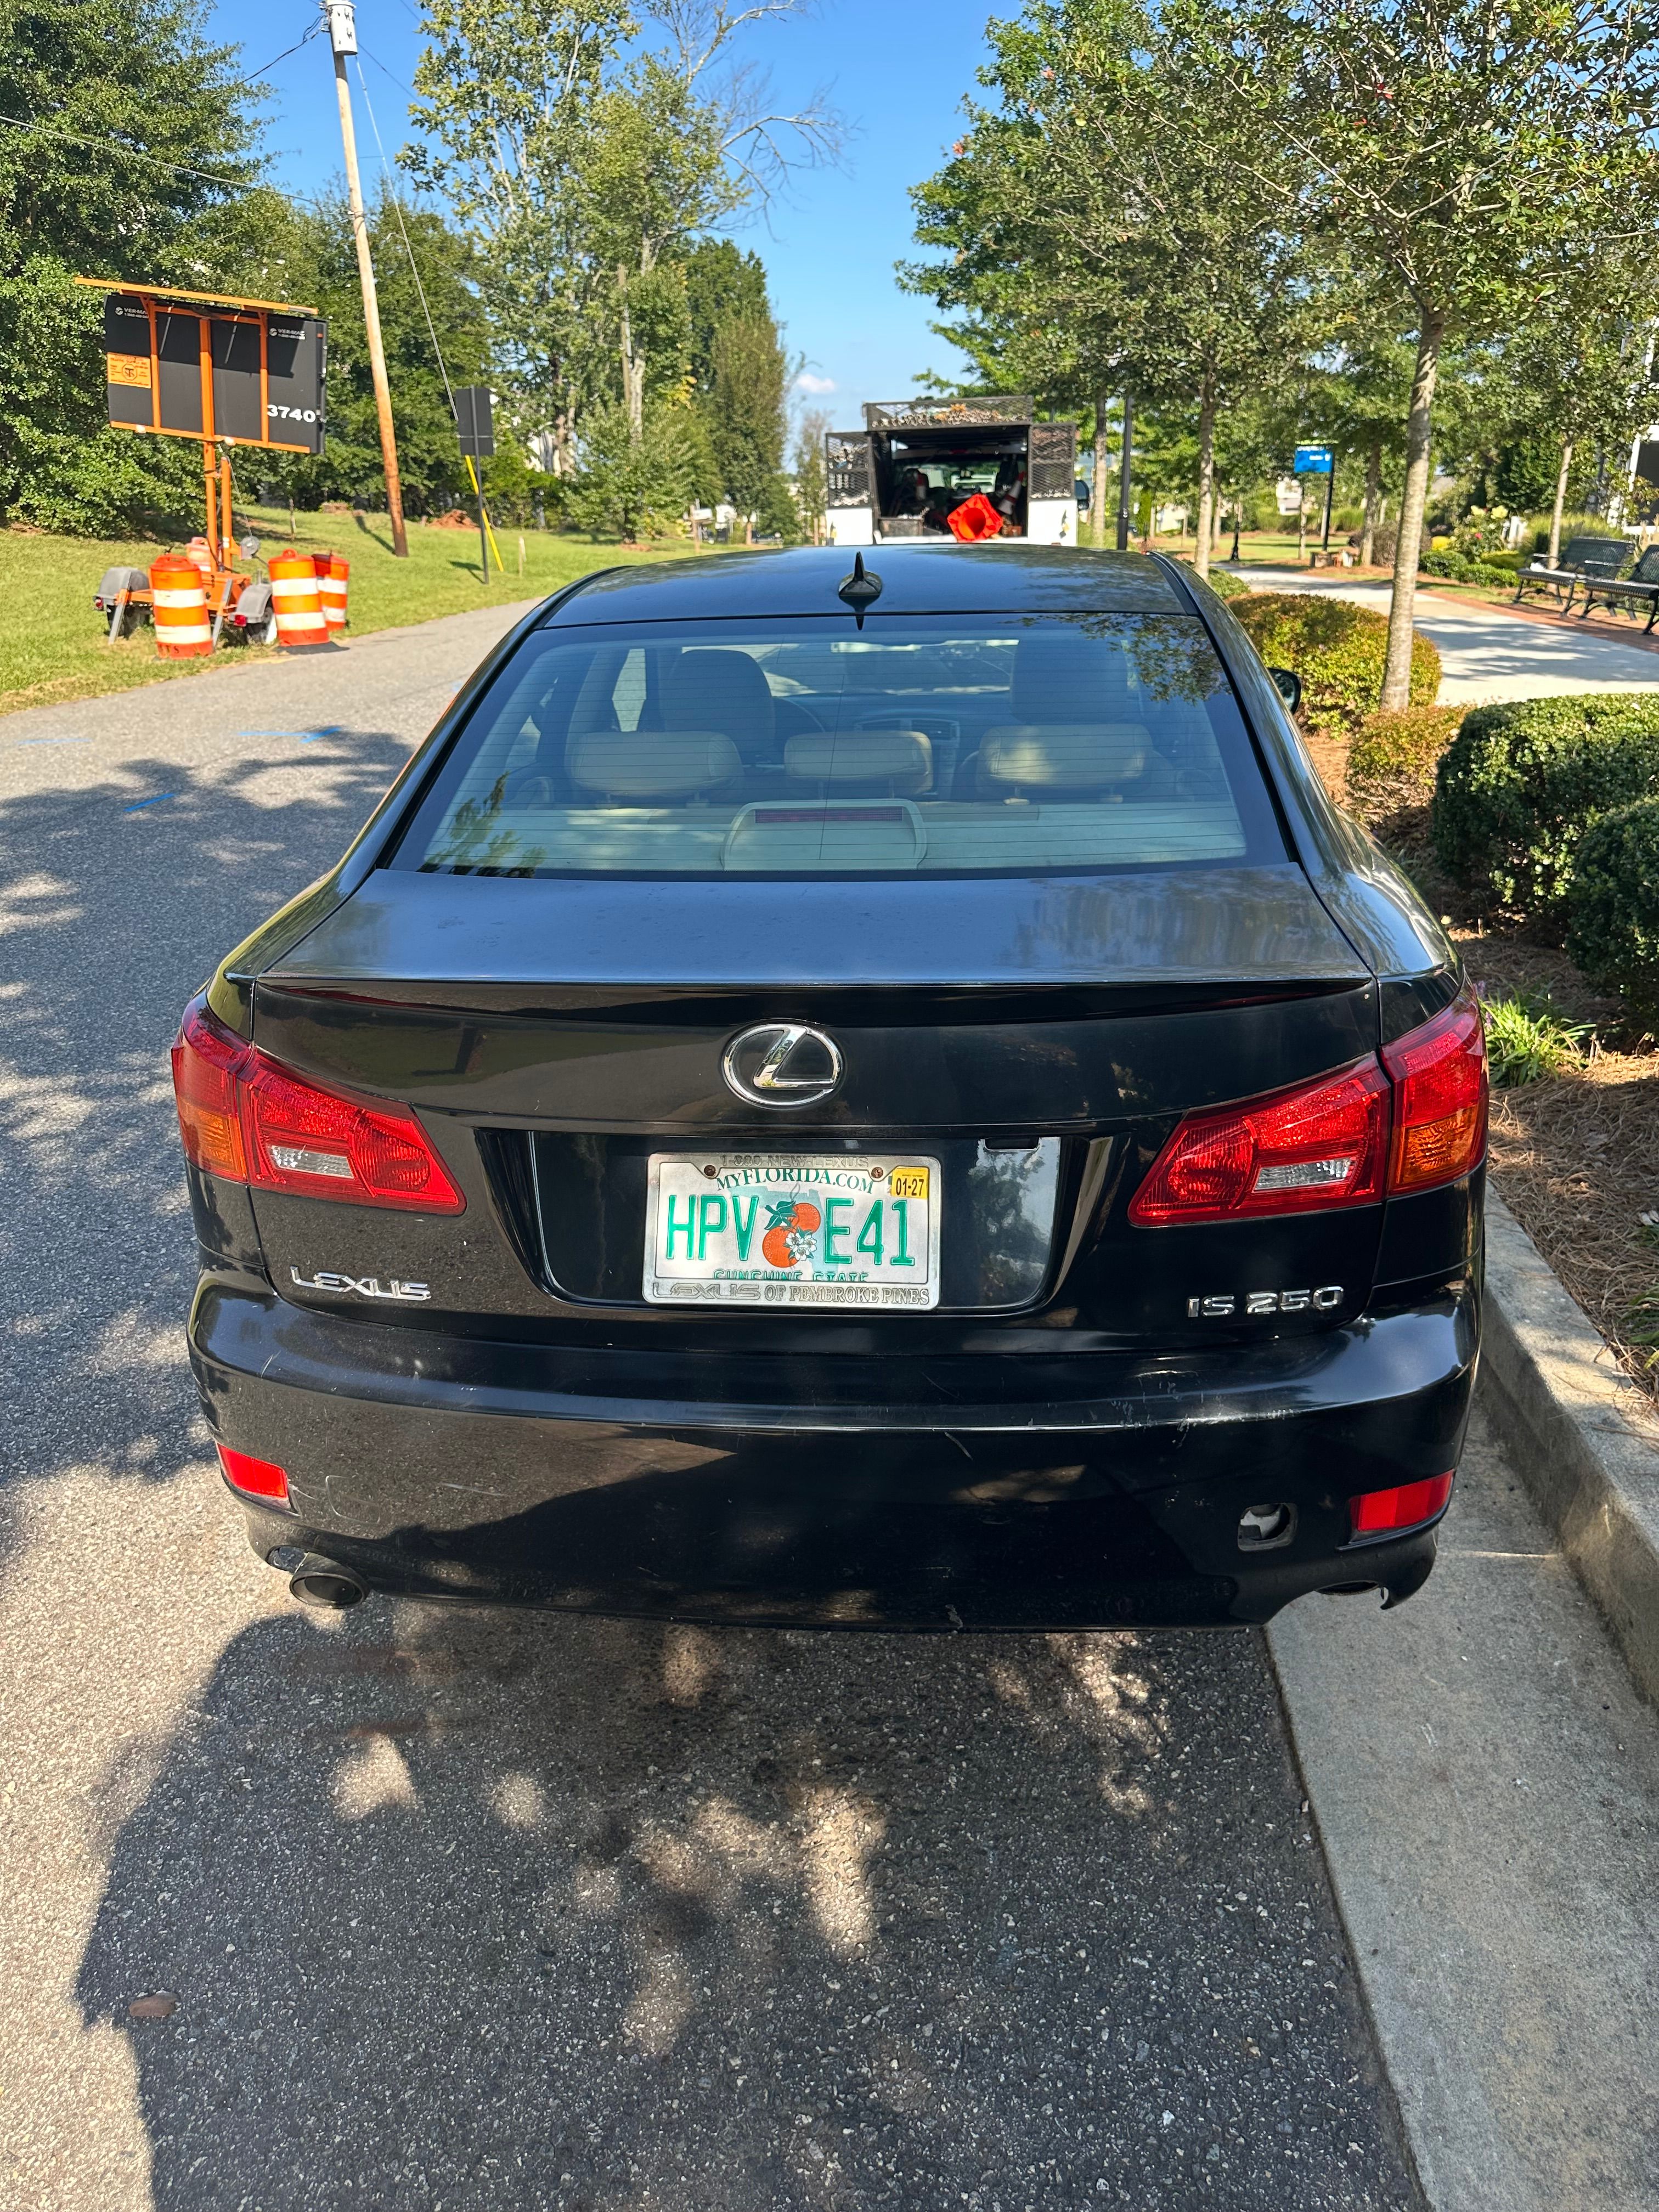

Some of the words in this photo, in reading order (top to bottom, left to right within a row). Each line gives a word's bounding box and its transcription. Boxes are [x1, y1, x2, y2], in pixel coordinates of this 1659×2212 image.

[267, 404, 316, 423] 3740
[719, 1154, 869, 1168] 1-800-NEW-LEXUS
[715, 1168, 874, 1194] MYFLORIDA.COM
[896, 1177, 924, 1197] 01-27
[666, 1194, 759, 1261] HPV
[824, 1198, 915, 1266] E41
[290, 1265, 432, 1301] LEXUS
[653, 1283, 761, 1300] LEXUS
[764, 1284, 786, 1301] OF
[789, 1286, 878, 1304] PEMBROKE
[881, 1288, 930, 1305] PINES
[1188, 1295, 1234, 1317] IS
[1246, 1286, 1344, 1314] 250
